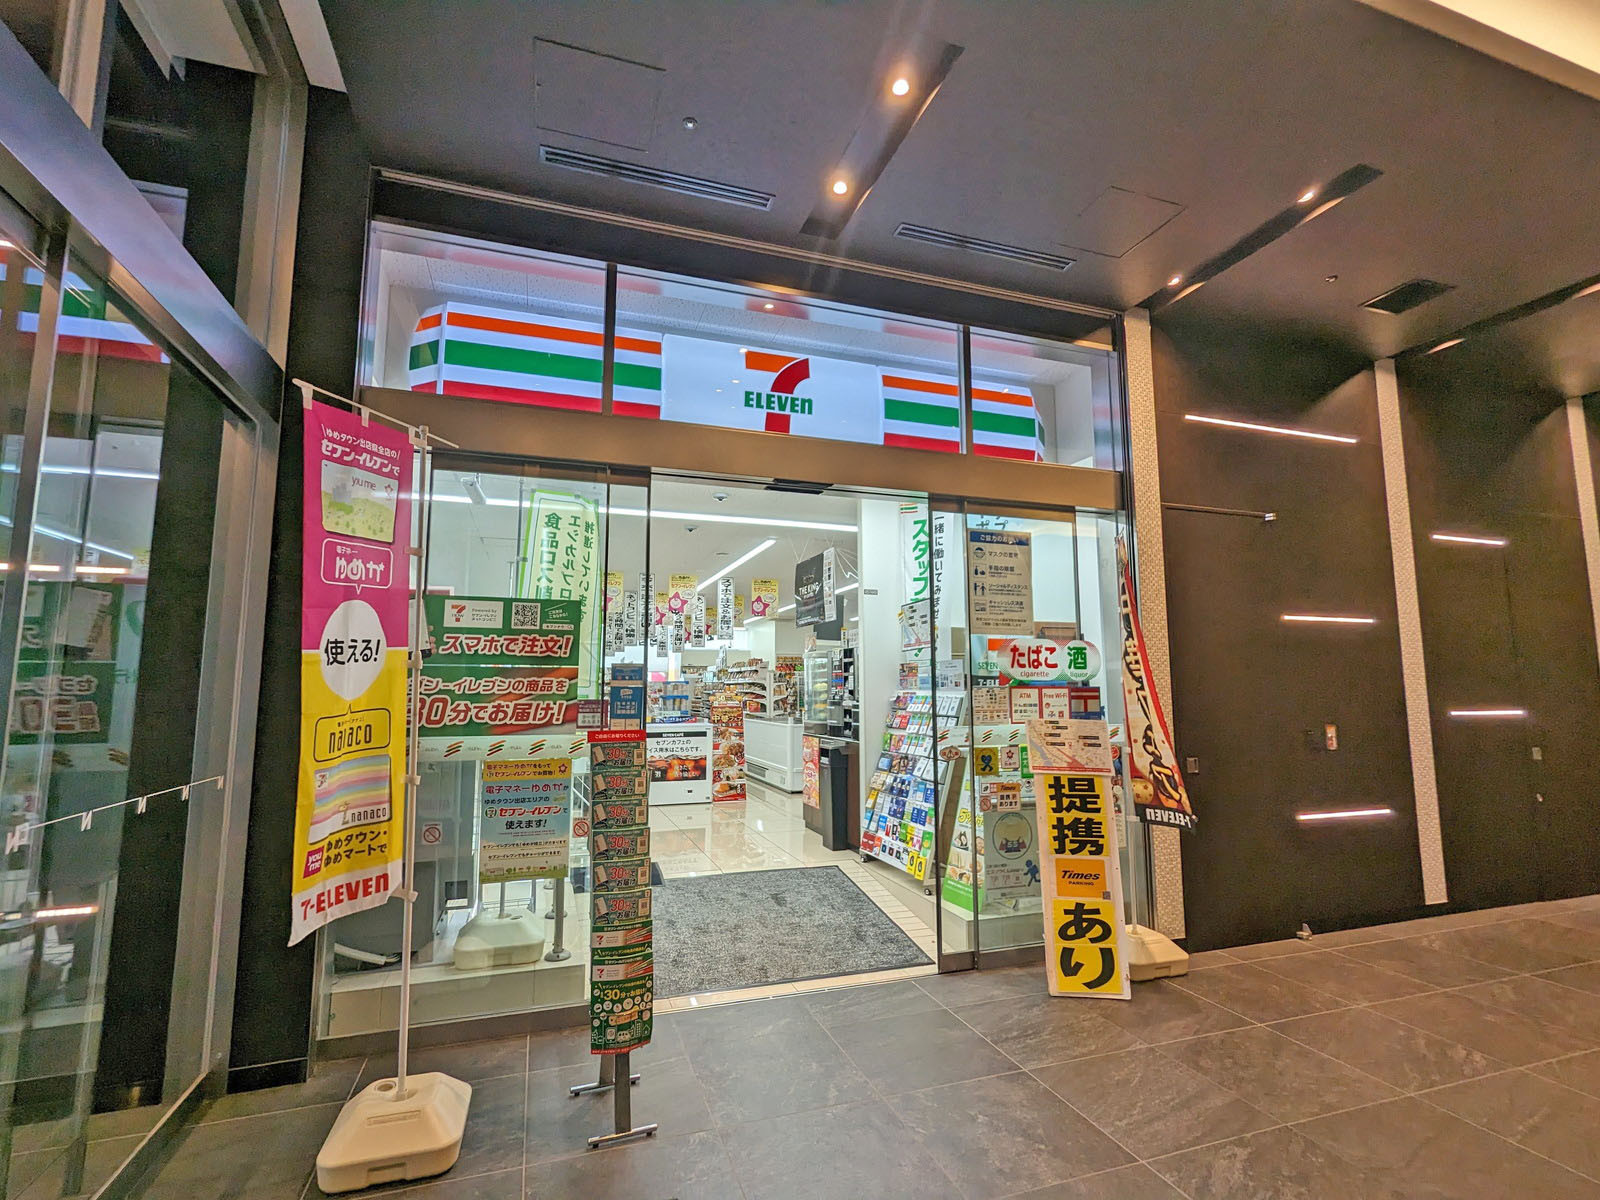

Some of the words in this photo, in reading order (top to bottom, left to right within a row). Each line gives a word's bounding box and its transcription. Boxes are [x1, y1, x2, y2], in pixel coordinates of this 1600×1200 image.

[325, 639, 380, 666] 使える!
[440, 634, 573, 657] スマホで注文!
[1010, 645, 1059, 669] たばこ
[1067, 646, 1088, 670] 酒
[352, 807, 386, 822] nanaco
[505, 819, 547, 830] 使えます!
[1048, 776, 1104, 856] 提携
[1061, 869, 1100, 881] Times
[1057, 902, 1116, 990] あり
